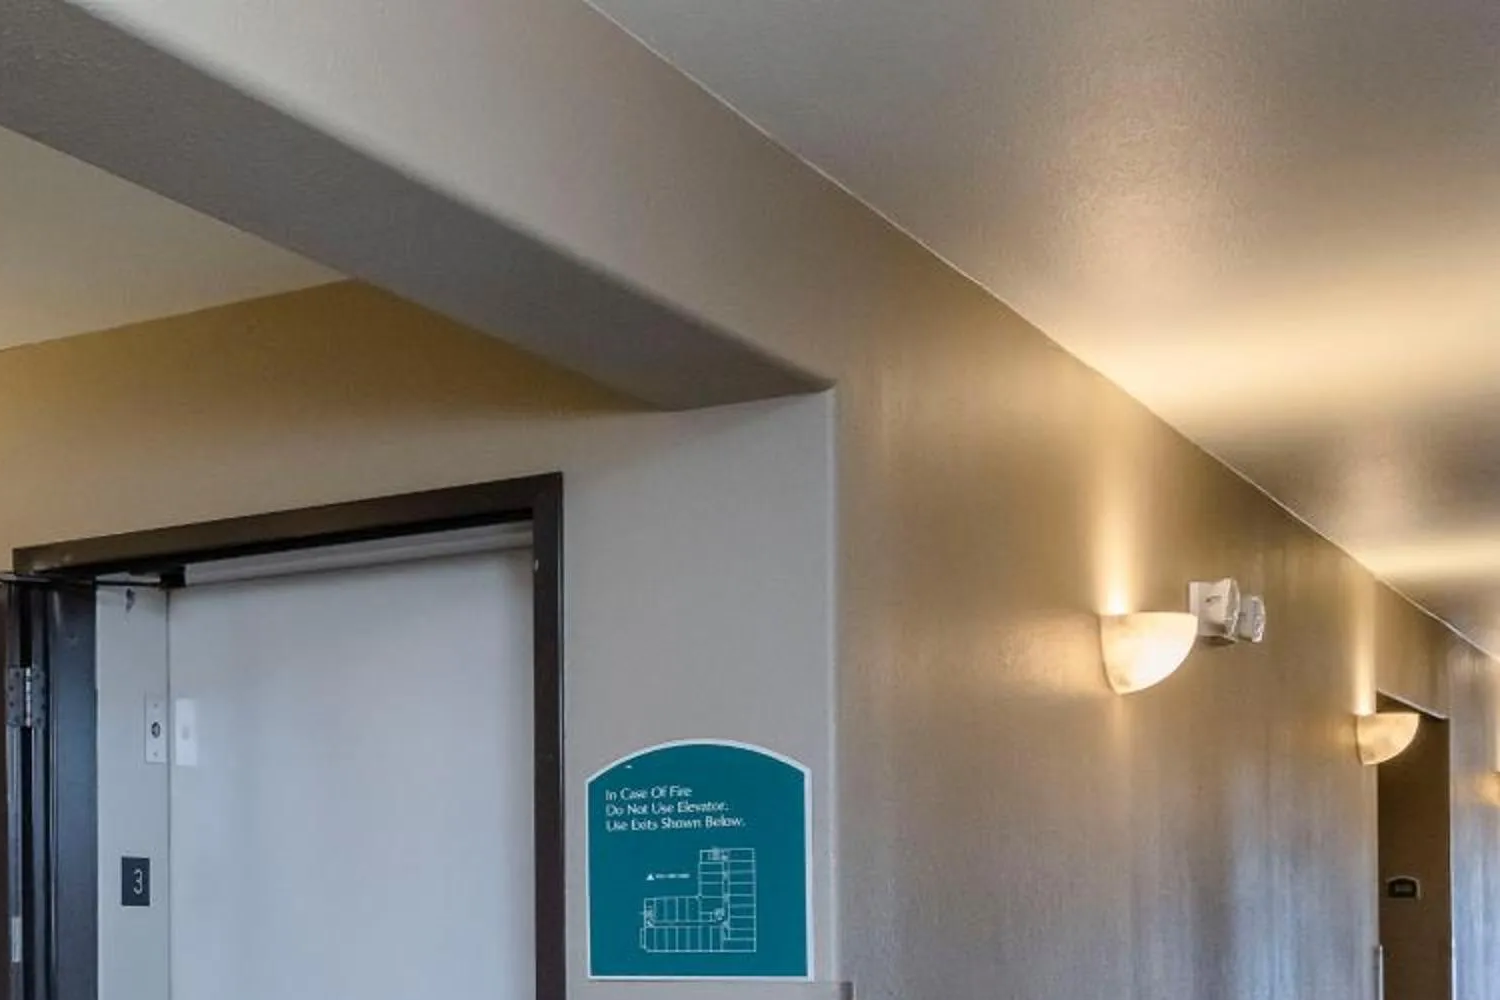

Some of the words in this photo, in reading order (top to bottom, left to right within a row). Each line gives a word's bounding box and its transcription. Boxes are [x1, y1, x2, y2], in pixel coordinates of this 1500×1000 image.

[605, 789, 618, 801] In
[620, 787, 648, 800] Case
[651, 785, 668, 799] Of
[669, 785, 693, 798] Fire
[605, 803, 624, 816] Do
[627, 802, 649, 815] Not
[651, 801, 674, 815] Use
[605, 819, 629, 832] Use
[631, 818, 659, 831] Exits
[660, 816, 702, 830] Shown
[705, 814, 747, 828] Below.
[133, 868, 143, 894] 3
